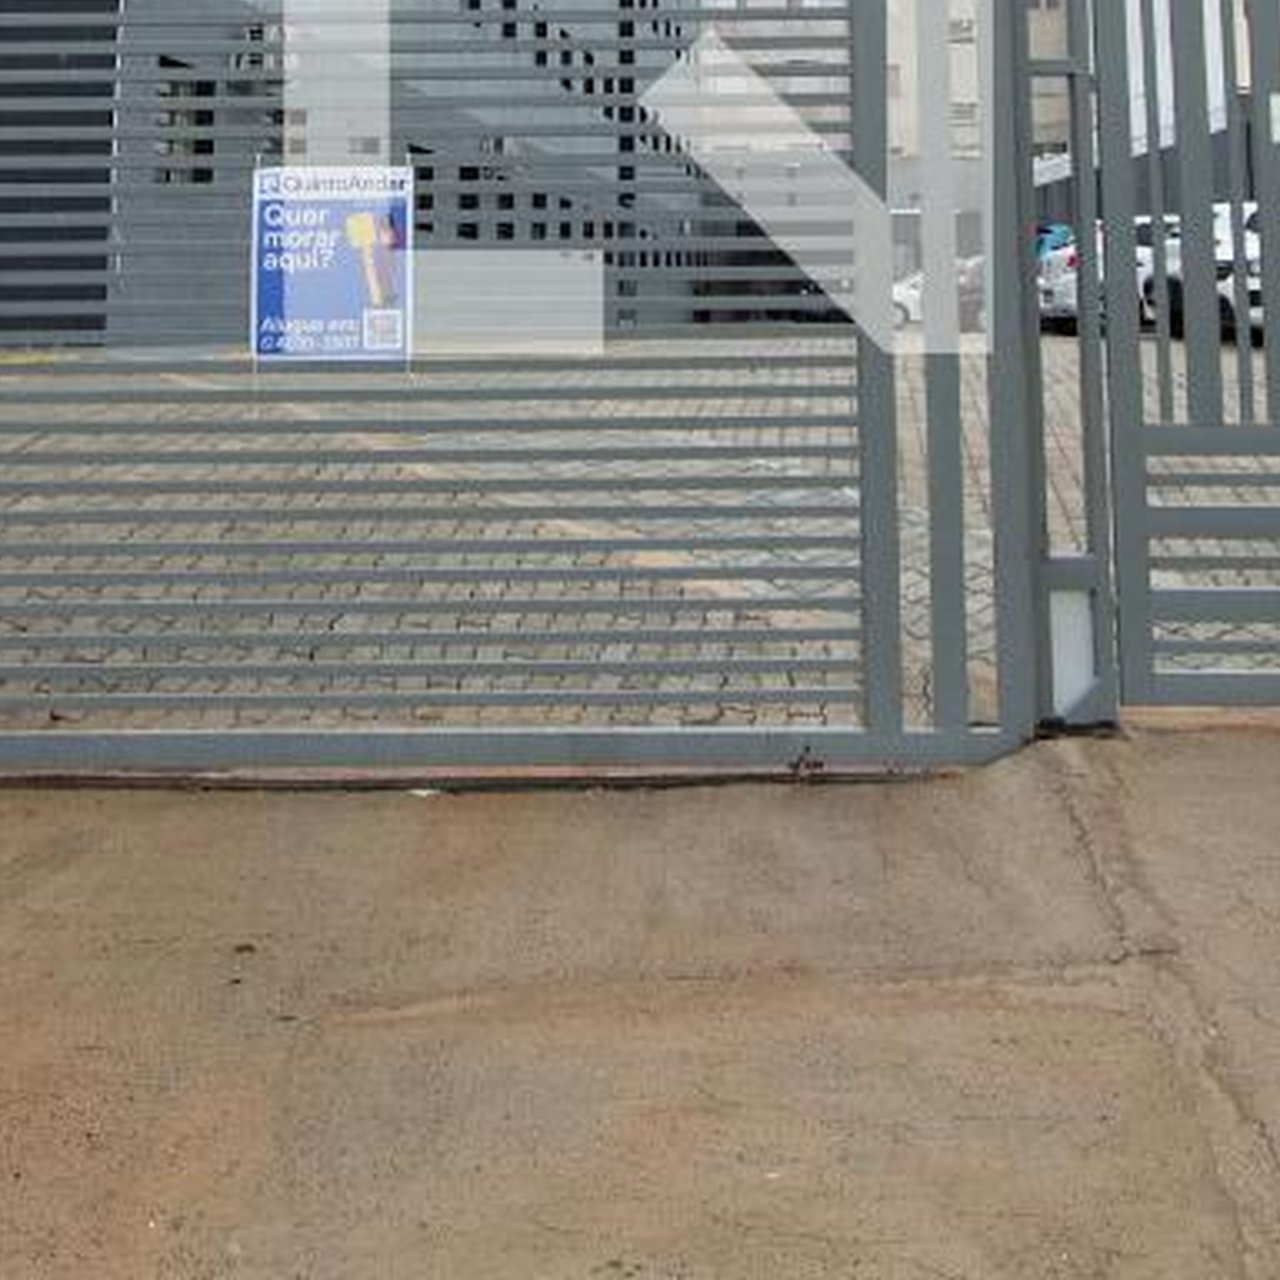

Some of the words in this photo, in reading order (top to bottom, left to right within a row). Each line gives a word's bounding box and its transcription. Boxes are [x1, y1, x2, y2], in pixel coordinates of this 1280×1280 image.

[282, 172, 406, 193] QuintoAndar
[263, 204, 330, 227] Quer
[263, 230, 339, 249] morar
[262, 250, 335, 275] aqui?
